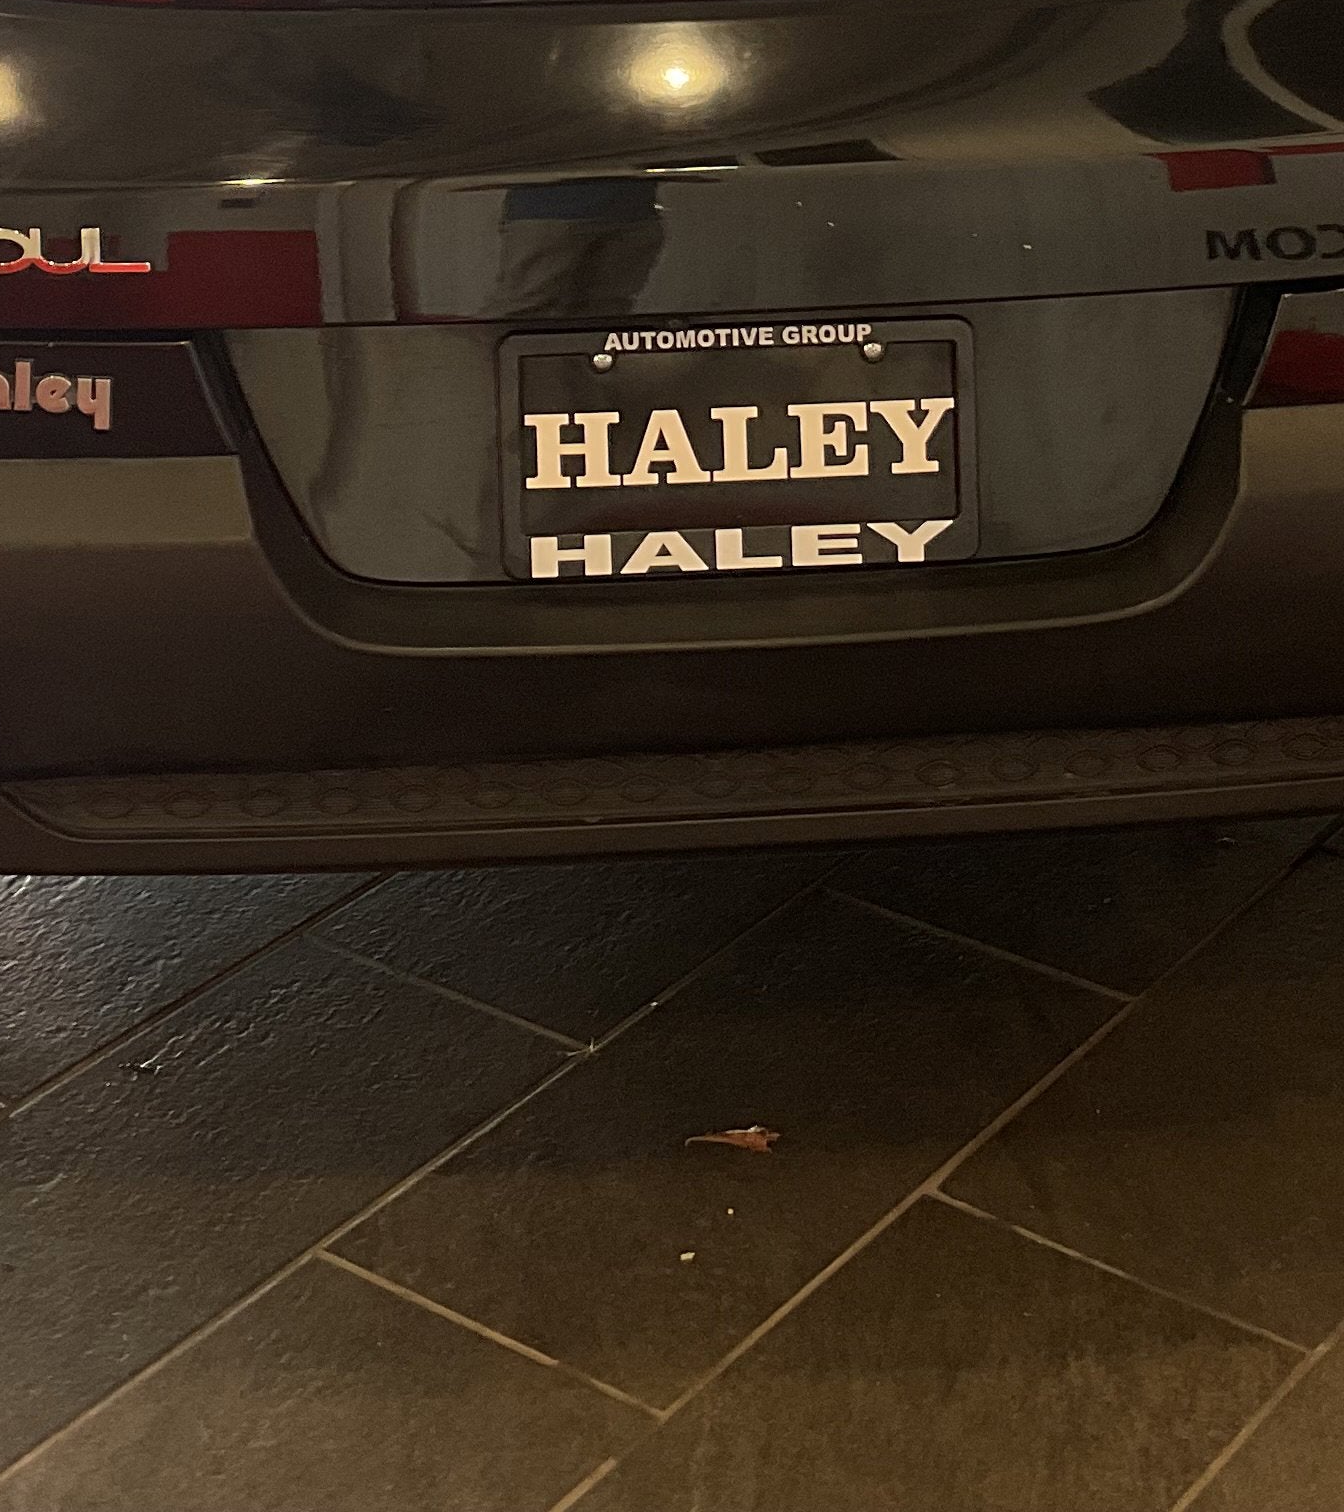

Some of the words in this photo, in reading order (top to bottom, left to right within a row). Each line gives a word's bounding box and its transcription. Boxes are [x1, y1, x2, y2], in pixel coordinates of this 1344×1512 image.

[604, 326, 775, 351] AUTOMOTIVE
[781, 324, 873, 345] GROUP
[524, 397, 955, 490] HALEY
[530, 520, 954, 579] HALEY
